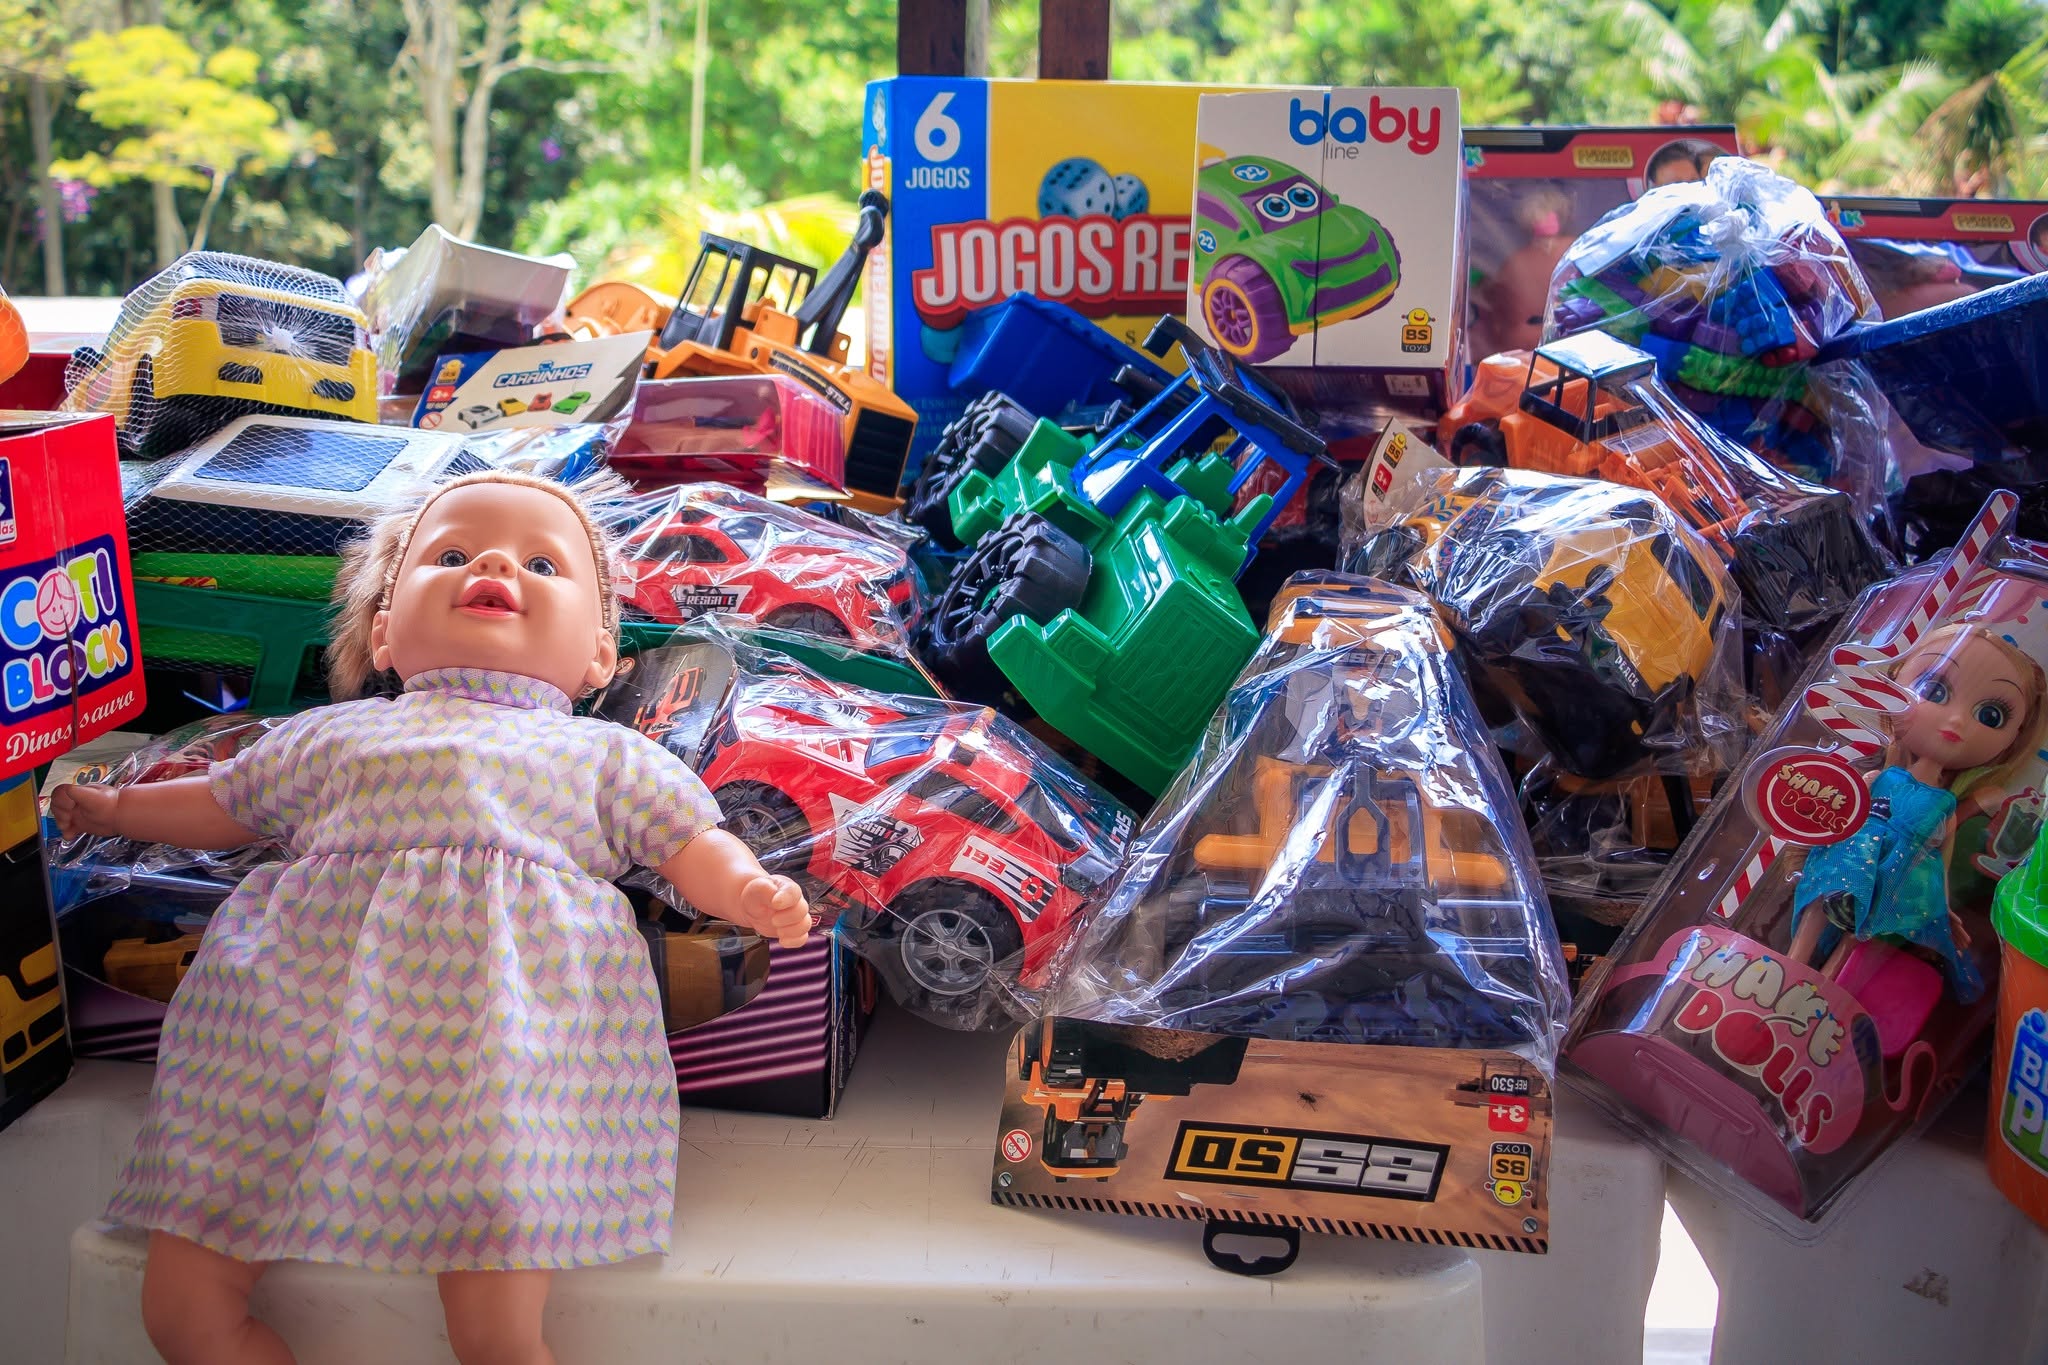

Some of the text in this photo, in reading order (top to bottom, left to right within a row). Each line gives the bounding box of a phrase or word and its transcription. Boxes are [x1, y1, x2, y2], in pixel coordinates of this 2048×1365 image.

[914, 91, 962, 163] 6
[1324, 141, 1360, 160] line
[905, 166, 971, 189] JOGOS
[1236, 165, 1267, 180] 22
[1405, 329, 1429, 341] BS
[1404, 344, 1429, 352] TOYS
[495, 364, 592, 388] CARRINHOS
[686, 595, 736, 605] RESGATE
[3, 619, 128, 713] BLOCK
[1614, 655, 1640, 688] PEACE
[1777, 763, 1848, 811] SHAKE
[1667, 935, 1846, 1068] SHAKE
[1674, 988, 1834, 1146] DOLLS
[1491, 1077, 1515, 1092] 530
[1492, 1104, 1525, 1123] 3+
[1495, 1144, 1529, 1155] TOYS
[1495, 1158, 1526, 1177] BS
